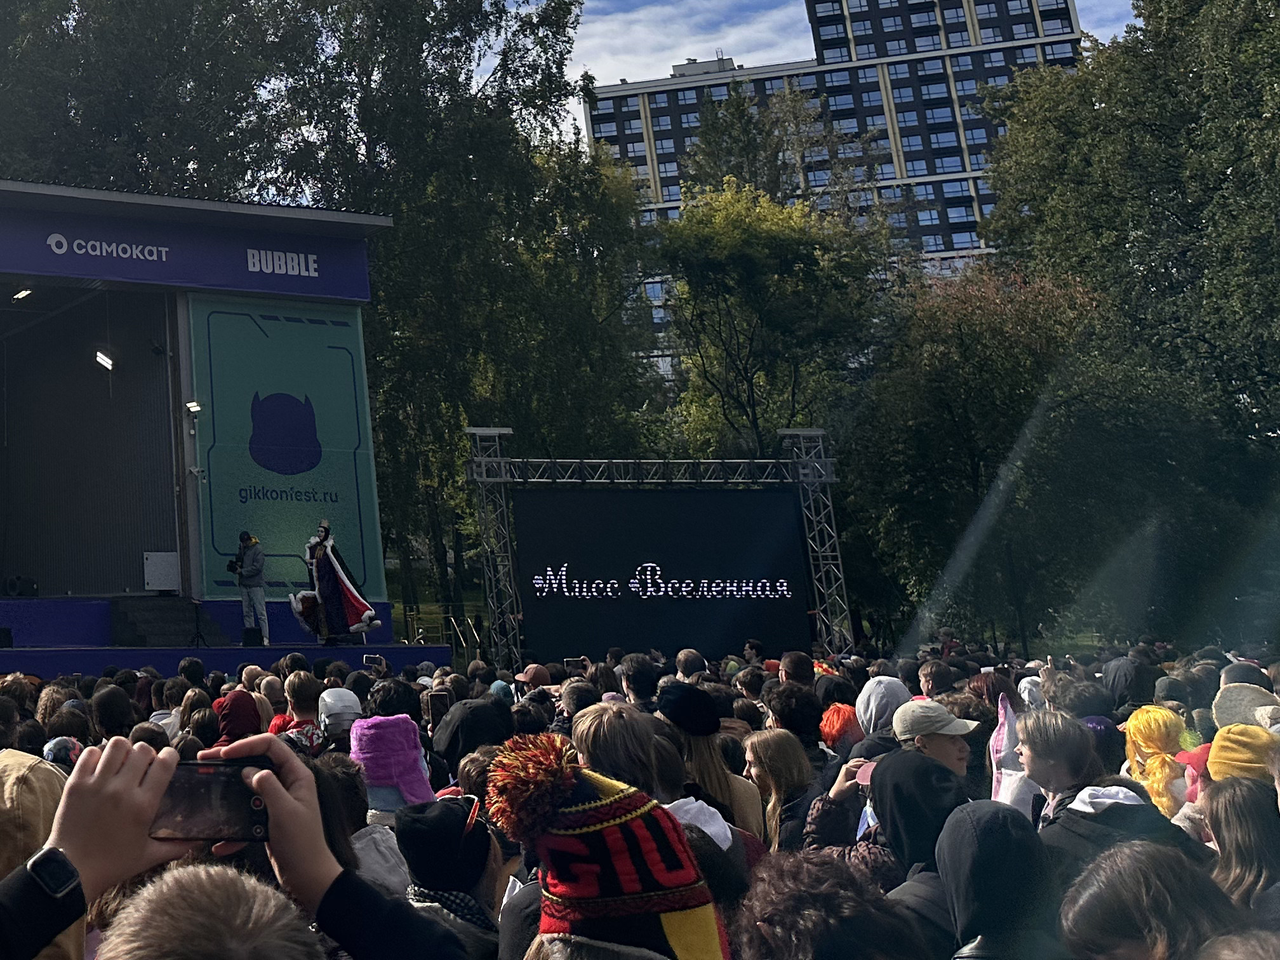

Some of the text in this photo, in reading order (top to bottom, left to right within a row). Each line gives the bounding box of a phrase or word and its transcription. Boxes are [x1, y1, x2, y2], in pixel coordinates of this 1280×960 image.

[72, 239, 169, 262] самокат
[246, 248, 319, 277] BUBBLE
[238, 485, 339, 504] gikkonfest.ru
[532, 562, 793, 599] Мисс Вселенная
